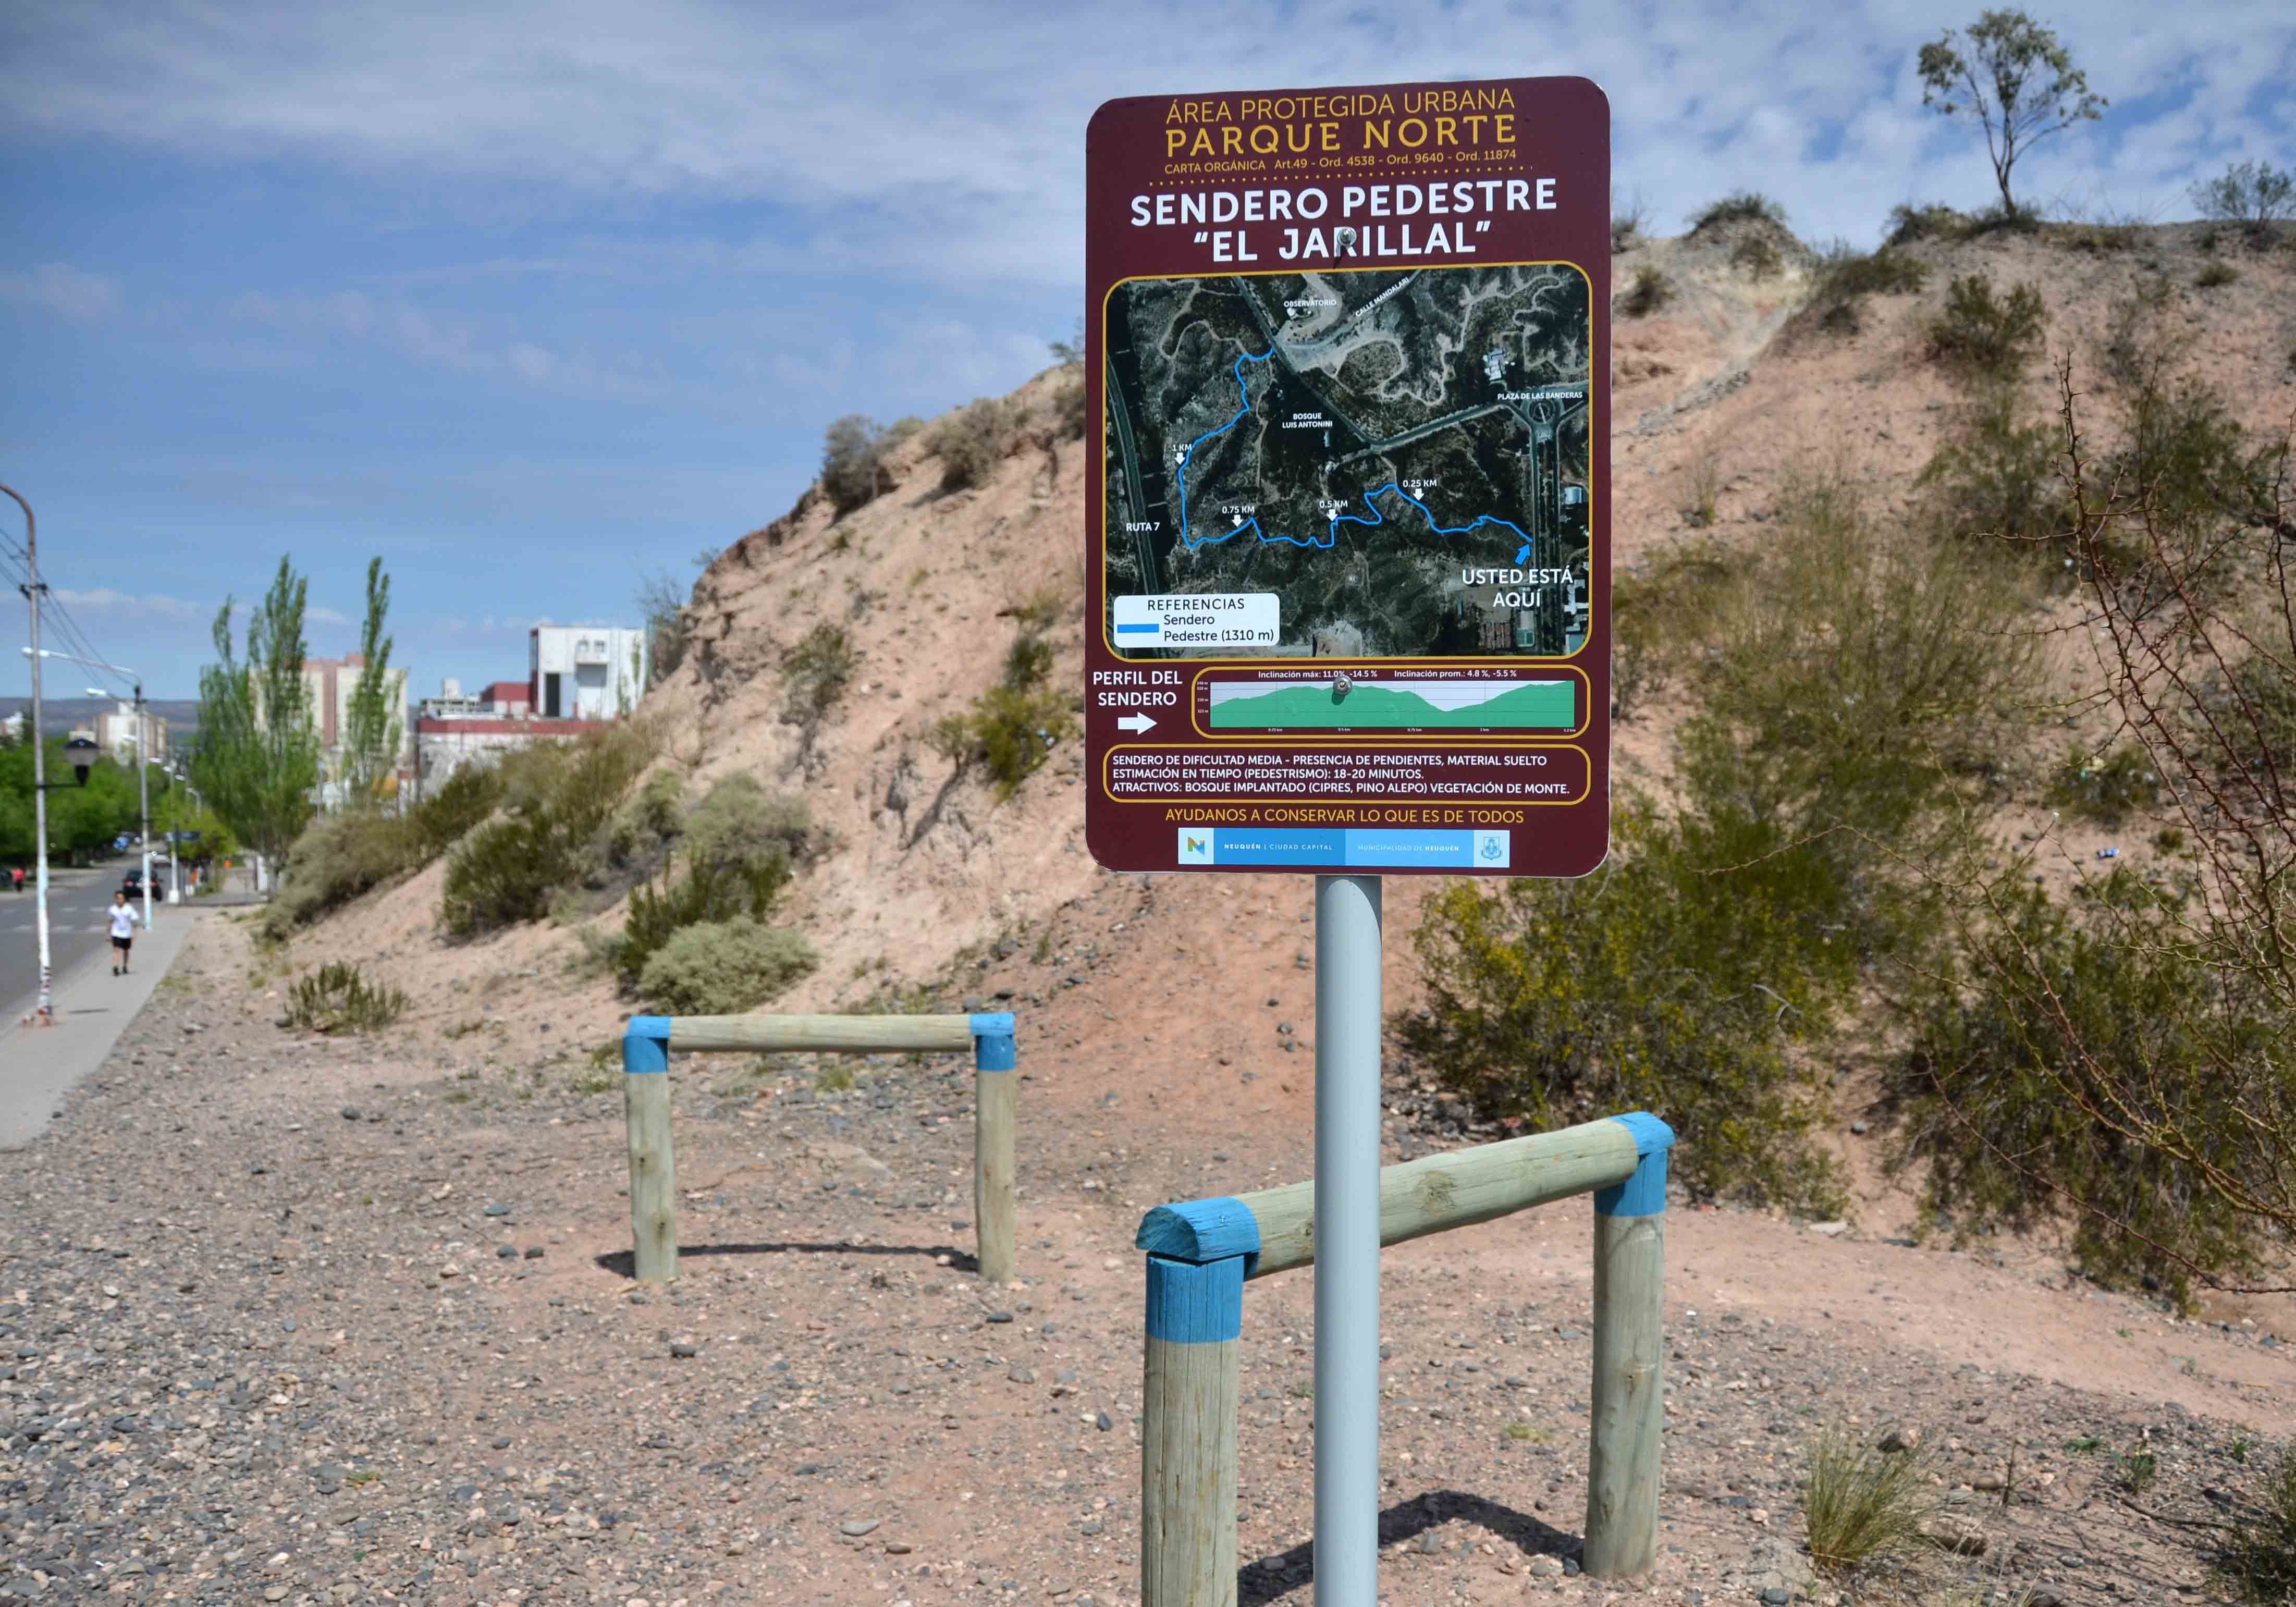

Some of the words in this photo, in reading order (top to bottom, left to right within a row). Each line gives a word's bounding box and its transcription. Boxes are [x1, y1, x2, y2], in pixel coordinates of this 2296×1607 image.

[1166, 99, 1232, 124] ÁREA
[1242, 93, 1395, 121] PROTEGIDA
[1404, 88, 1515, 113] URBANA
[1165, 122, 1341, 157] PARQUE
[1363, 114, 1516, 149] NORTE
[1164, 162, 1201, 174] CARTA
[1204, 158, 1266, 172] ORGÁNICA
[1274, 158, 1307, 169] Art.49
[1319, 156, 1343, 167] Ord.
[1346, 155, 1374, 166] 4538
[1386, 153, 1411, 165] Ord.
[1415, 152, 1444, 163] 9640
[1456, 151, 1480, 162] Ord.
[1484, 150, 1516, 160] 11874
[1131, 188, 1328, 226] SENDERO
[1343, 178, 1557, 217] PEDESTRE
[1283, 299, 1337, 308] OBSERVATORIO
[1355, 301, 1376, 317] CALLE
[1373, 277, 1409, 306] MANDALARI
[1126, 522, 1152, 531] RUTA
[1153, 522, 1160, 531] 7
[1462, 569, 1523, 584] USTED
[1529, 565, 1574, 584] ESTÁ
[1148, 598, 1245, 610] REFERENCIAS
[1492, 588, 1542, 607] AQUÍ
[1163, 614, 1215, 625] Sendero
[1164, 630, 1218, 642] Pedestre
[1221, 630, 1254, 642] (1310
[1258, 629, 1274, 642] m)
[1093, 671, 1147, 685] PERFIL
[1151, 670, 1183, 684] DEL
[1481, 670, 1490, 679] %,
[1098, 691, 1177, 706] SENDERO
[1113, 755, 1164, 765] SENDERO
[1166, 755, 1180, 765] DE
[1183, 755, 1245, 765] DIFICULTAD
[1248, 755, 1282, 765] MEDIA
[1293, 755, 1354, 765] PRESENCIA
[1356, 755, 1371, 765] DE
[1373, 755, 1444, 766] PENDIENTES,
[1447, 756, 1501, 765] MATERIAL
[1504, 756, 1547, 766] SUELTO
[1113, 767, 1180, 778] ESTIMACIÓN
[1182, 769, 1197, 778] EN
[1199, 769, 1242, 778] TIEMPO
[1244, 768, 1331, 780] (PEDESTRISMO):
[1334, 769, 1366, 779] 18-20
[1368, 769, 1424, 779] MINUTOS.
[1113, 782, 1182, 792] ATRACTIVOS:
[1185, 782, 1231, 793] BOSQUE
[1234, 782, 1306, 792] IMPLANTADO
[1309, 782, 1353, 794] (CIPRES,
[1356, 783, 1385, 792] PINO
[1388, 782, 1428, 794] ALEPO)
[1430, 781, 1504, 793] VEGETACIÓN
[1506, 783, 1521, 793] DE
[1525, 783, 1570, 794] MONTE.
[1165, 808, 1247, 821] AYUDANOS
[1250, 809, 1261, 821] A
[1264, 809, 1356, 822] CONSERVAR
[1360, 809, 1380, 822] LO
[1384, 810, 1417, 823] QUE
[1422, 810, 1440, 823] ES
[1444, 811, 1464, 823] DE
[1468, 811, 1524, 823] TODOS
